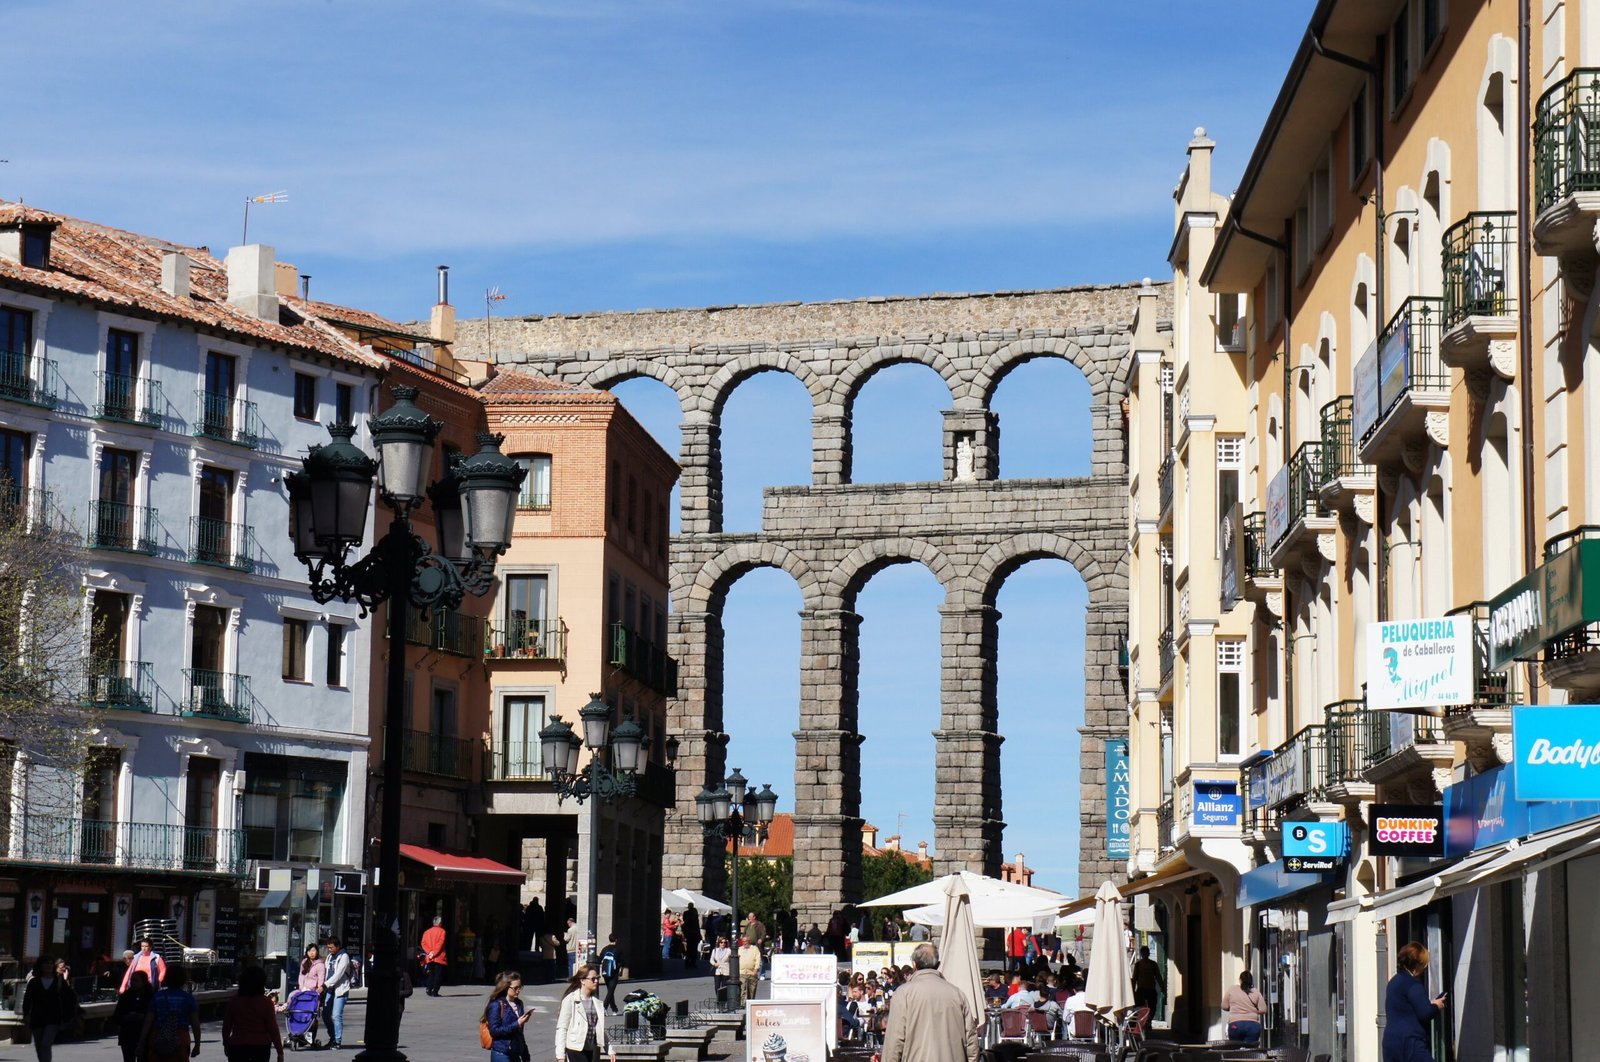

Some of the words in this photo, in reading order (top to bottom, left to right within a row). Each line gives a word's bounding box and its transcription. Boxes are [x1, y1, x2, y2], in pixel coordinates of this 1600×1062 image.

[1382, 620, 1454, 643] PELUQUERIA
[1403, 645, 1412, 656] de
[1415, 642, 1455, 656] Caballeros
[1113, 759, 1129, 819] AMADO
[1197, 802, 1234, 812] Allianz
[1202, 813, 1228, 823] Seguros
[1377, 817, 1438, 831] DUNKIN'
[1296, 830, 1304, 838] B
[1377, 830, 1434, 843] COFFEE
[1308, 829, 1327, 853] S
[1303, 861, 1333, 869] ServiRed
